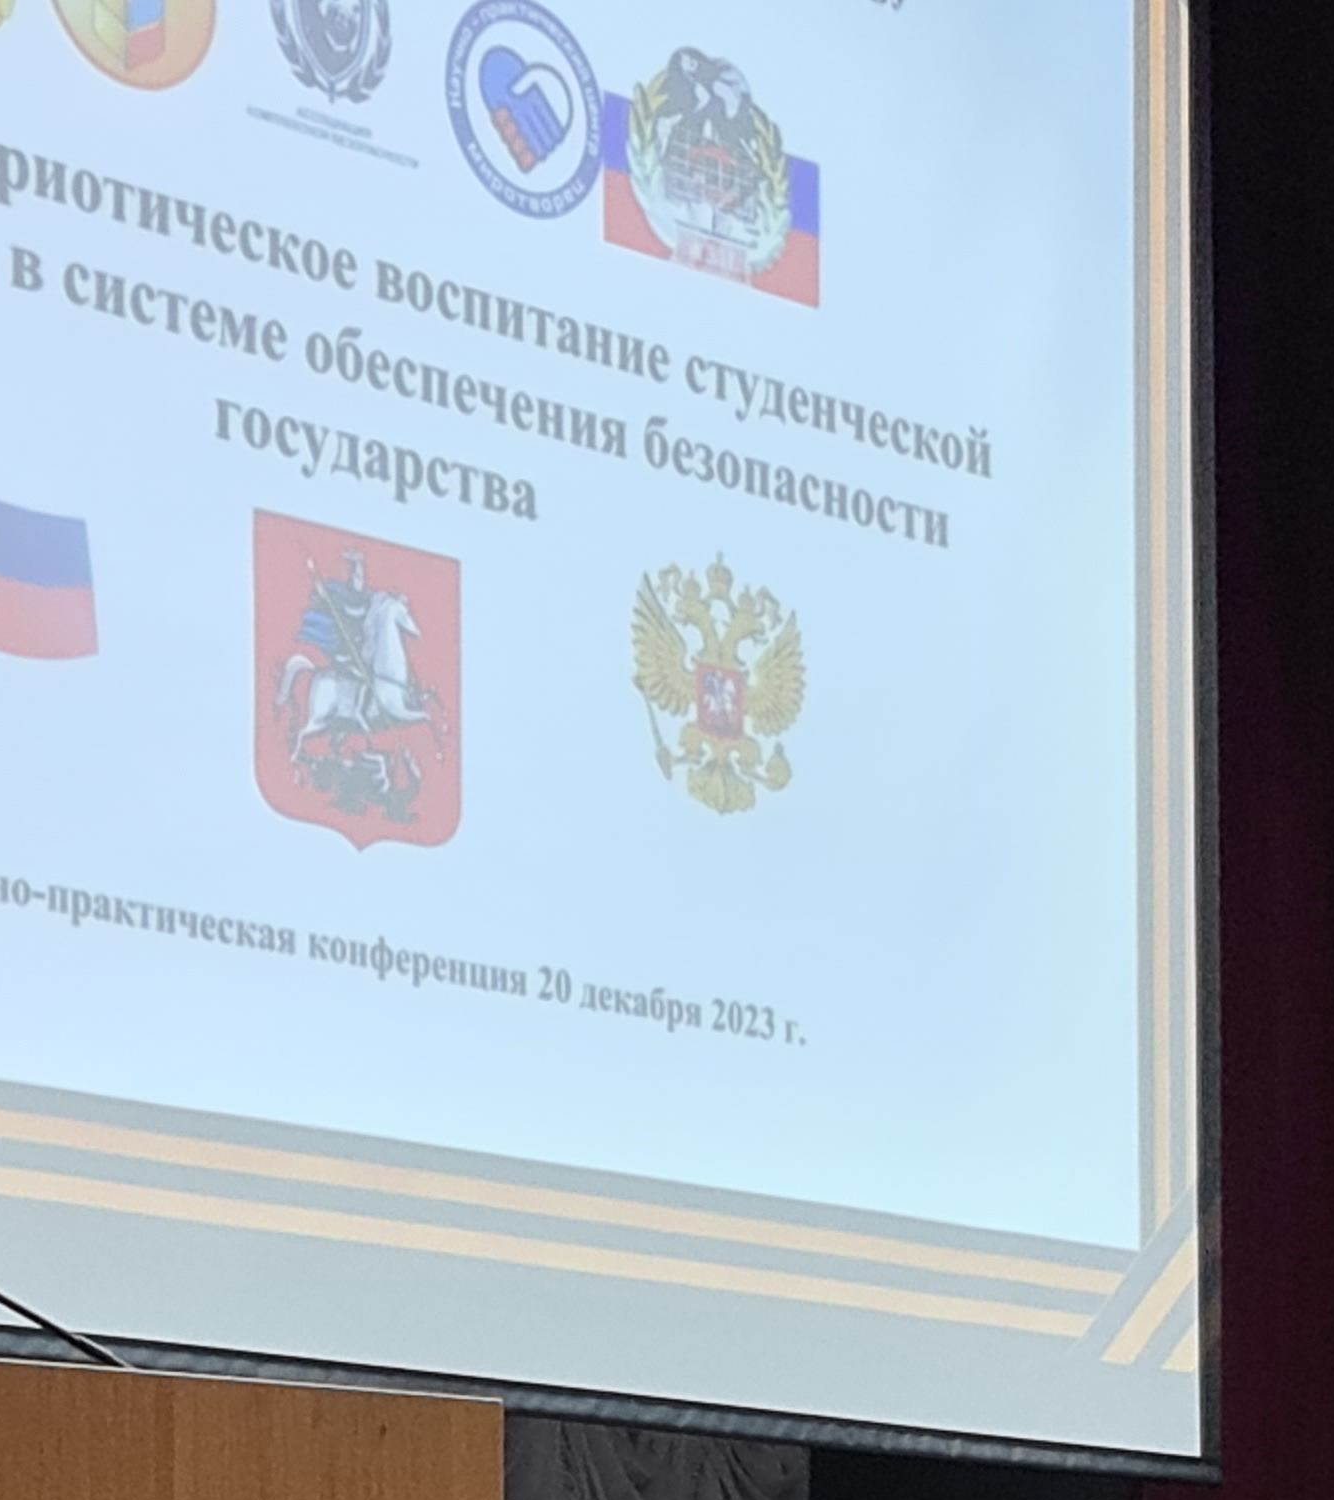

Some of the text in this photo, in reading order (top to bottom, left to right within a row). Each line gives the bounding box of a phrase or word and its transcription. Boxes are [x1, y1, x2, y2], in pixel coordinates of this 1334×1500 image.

[10, 244, 44, 292] в
[63, 261, 287, 362] системе
[304, 326, 627, 460] обеспечения
[643, 415, 949, 548] безопасности
[375, 258, 670, 383] воспитание
[684, 354, 992, 478] студенческой
[214, 397, 538, 522] государства
[308, 931, 527, 997] конференция
[538, 965, 572, 1004] 20
[578, 983, 702, 1033] декабря
[711, 998, 775, 1040] 2023
[784, 1020, 807, 1046] г.
